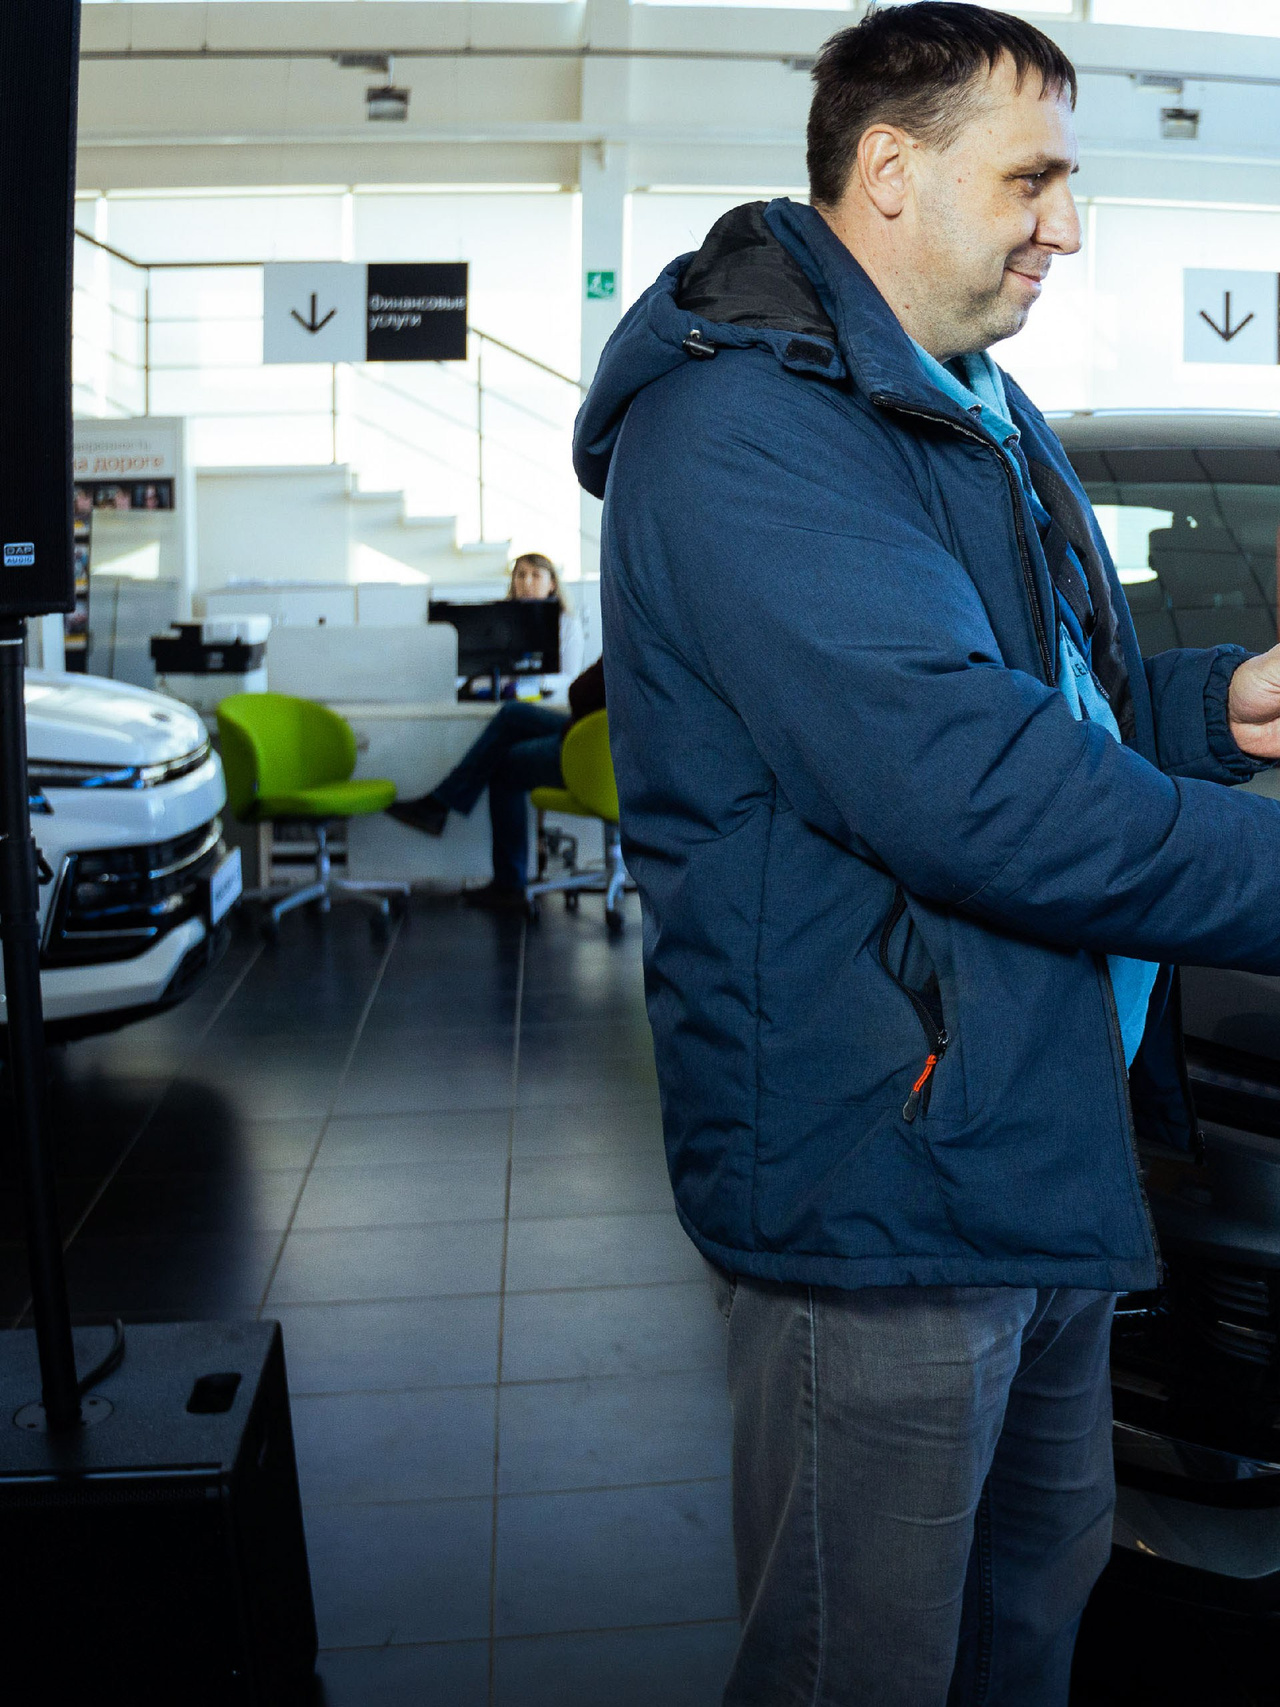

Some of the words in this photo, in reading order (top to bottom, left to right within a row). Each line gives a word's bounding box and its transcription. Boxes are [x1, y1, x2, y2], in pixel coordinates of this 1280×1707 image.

[368, 293, 467, 312] Финансовые
[368, 312, 422, 332] услуги
[6, 546, 32, 556] DAP
